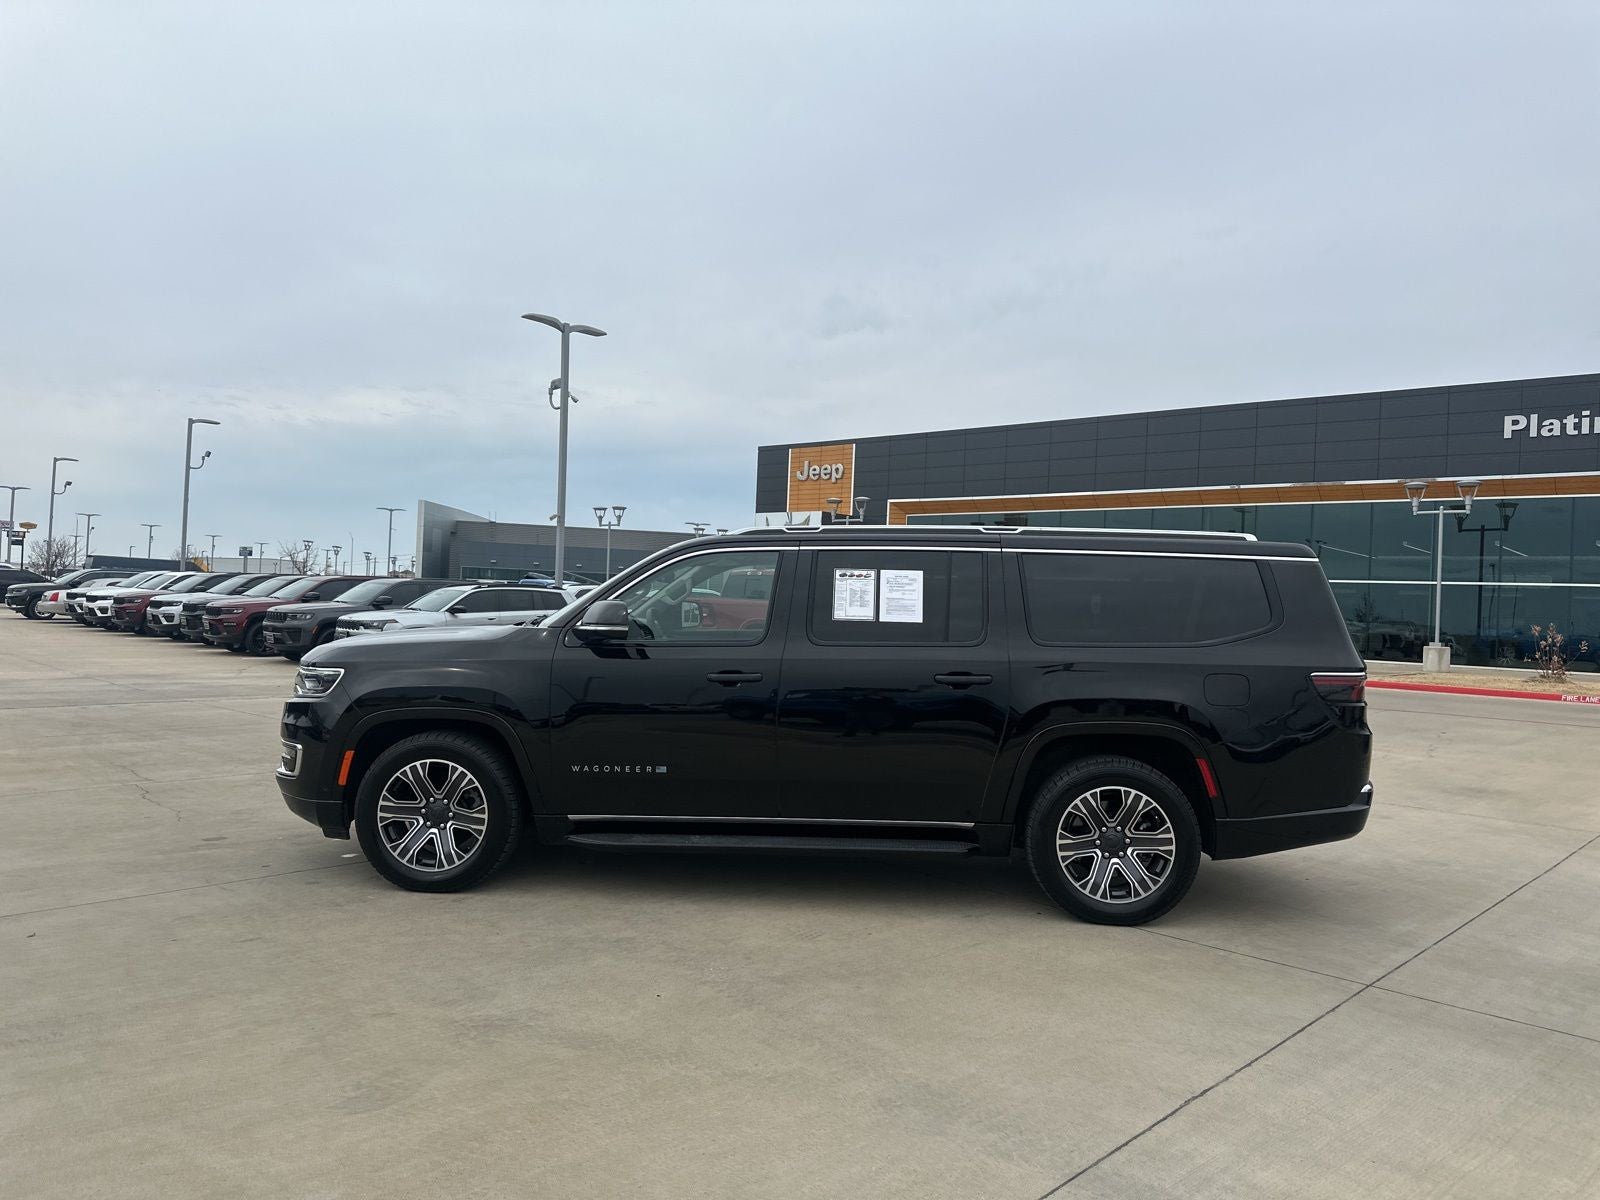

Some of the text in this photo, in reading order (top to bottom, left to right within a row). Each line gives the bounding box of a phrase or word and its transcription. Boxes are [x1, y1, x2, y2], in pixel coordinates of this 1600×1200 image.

[796, 460, 844, 484] Jeep
[1561, 694, 1600, 704] FIRE LANE
[571, 765, 652, 773] WAGONEER
